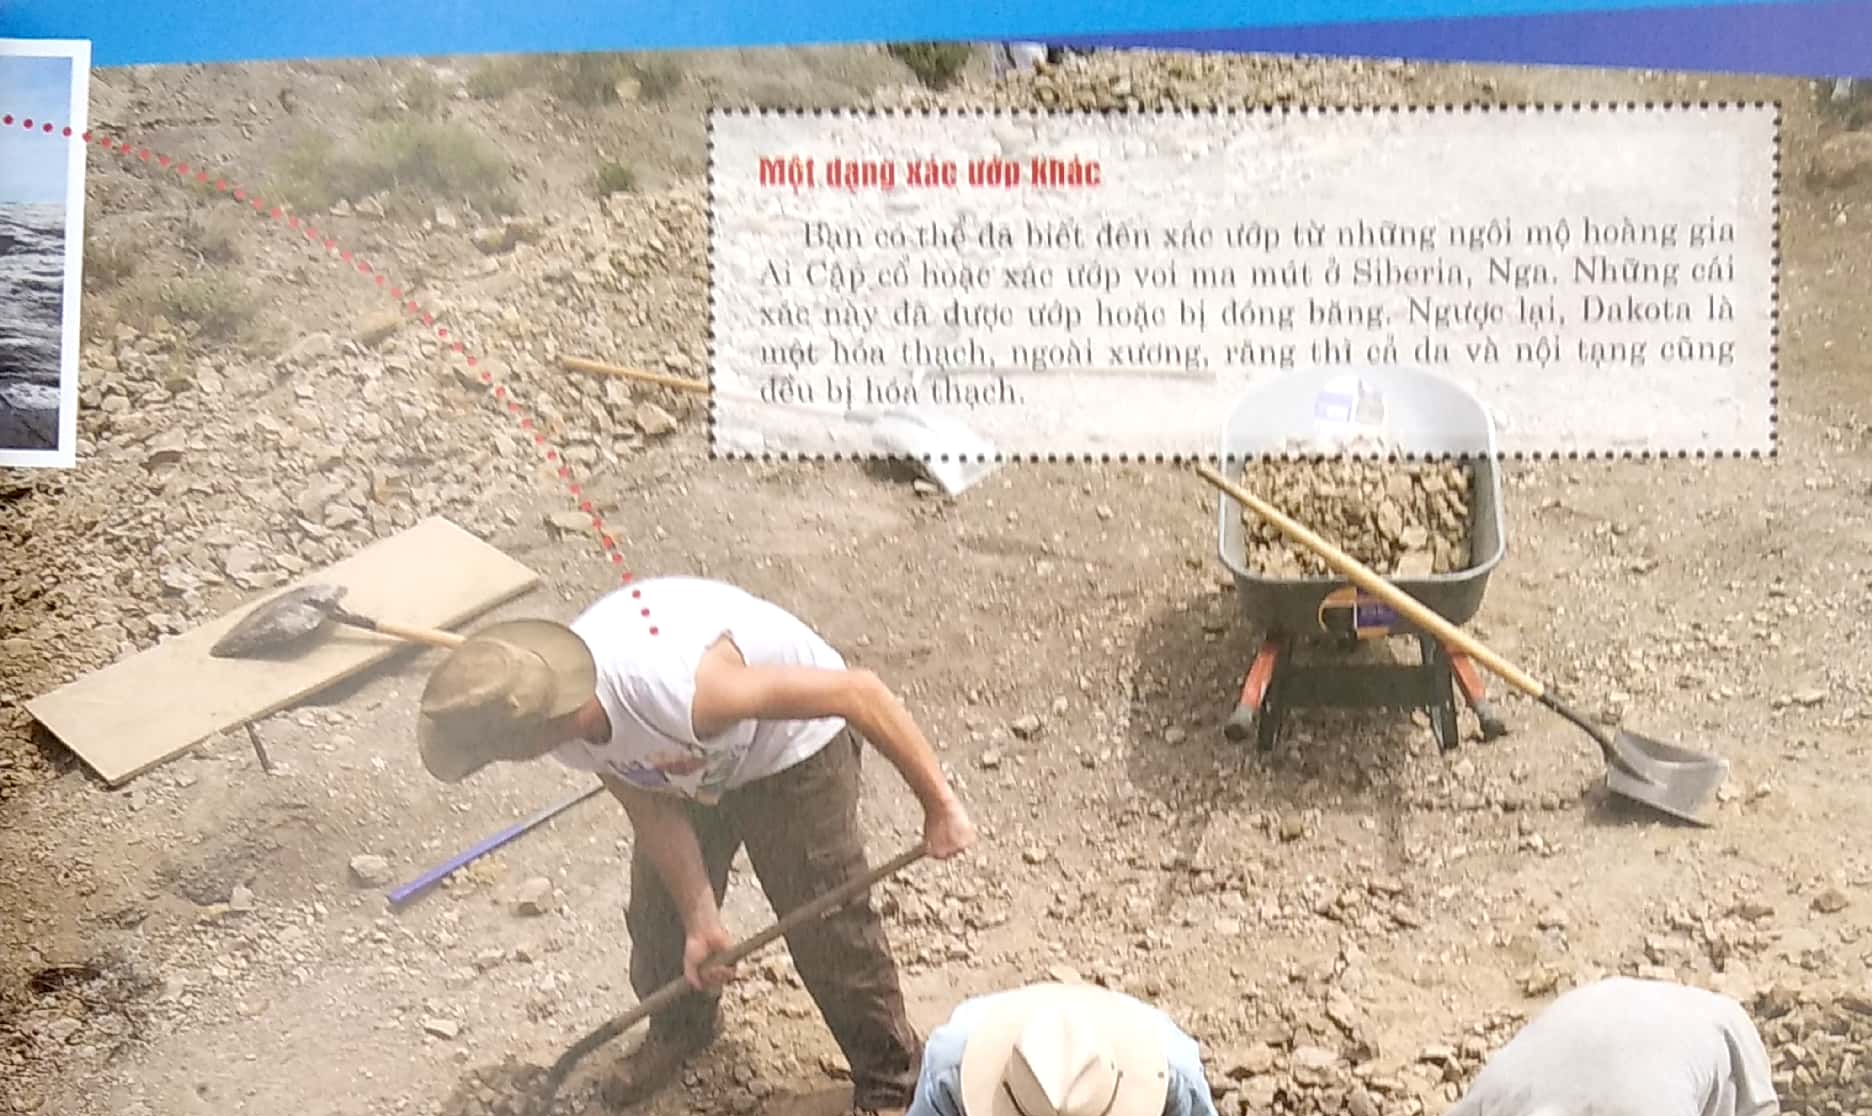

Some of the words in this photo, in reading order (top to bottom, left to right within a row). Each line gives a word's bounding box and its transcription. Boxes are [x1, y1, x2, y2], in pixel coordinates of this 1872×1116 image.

[759, 157, 815, 194] Một
[826, 157, 896, 192] dạng
[906, 156, 958, 187] xác
[968, 157, 1021, 188] ướp
[804, 221, 862, 250] Bạn
[874, 224, 908, 247] có
[1027, 221, 1083, 247] biết
[1096, 221, 1150, 247] đến
[1163, 221, 1213, 246] xác
[1225, 221, 1280, 253] ướp
[1293, 220, 1326, 246] từ
[1338, 219, 1437, 250] những
[1449, 220, 1512, 251] ngôi
[1526, 220, 1570, 252] mộ
[1584, 218, 1678, 250] hoàng
[1690, 218, 1734, 250] gia
[761, 261, 792, 288] Ai
[807, 260, 866, 291] Cập
[878, 254, 911, 288] cổ
[923, 262, 991, 290] hoặc
[1003, 262, 1053, 288] xác
[1068, 263, 1120, 293] ướp
[1134, 260, 1177, 287] voi
[1192, 268, 1235, 287] ma
[1251, 262, 1312, 287] mút
[1325, 255, 1342, 286] ở
[1353, 256, 1474, 289] Siberia,
[1488, 258, 1559, 289] Nga.
[1573, 255, 1680, 289] Những
[1691, 258, 1734, 283] cái
[760, 301, 809, 328] xác
[824, 301, 879, 332] này
[1028, 301, 1082, 332] ướp
[1096, 300, 1166, 331] hoặc
[1180, 300, 1206, 332] bị
[1309, 299, 1391, 328] băng.
[1408, 295, 1504, 329] Ngược
[1519, 296, 1566, 328] lại,
[1582, 296, 1692, 322] Dakota
[1708, 296, 1733, 320] là
[760, 338, 819, 369] một
[832, 338, 887, 367] hóa
[902, 338, 997, 370] thạch,
[1012, 337, 1093, 375] ngoài
[1108, 339, 1211, 371] xương,
[1225, 338, 1295, 368] răng
[1311, 337, 1353, 364] thì
[1366, 334, 1397, 363] cả
[1414, 337, 1450, 363] da
[1466, 338, 1499, 362] và
[1515, 336, 1561, 368] nội
[1578, 338, 1647, 368] tạng
[1659, 337, 1735, 365] cũng
[826, 376, 853, 409] bị
[867, 376, 918, 405] hóa
[929, 375, 1025, 408] thạch.
